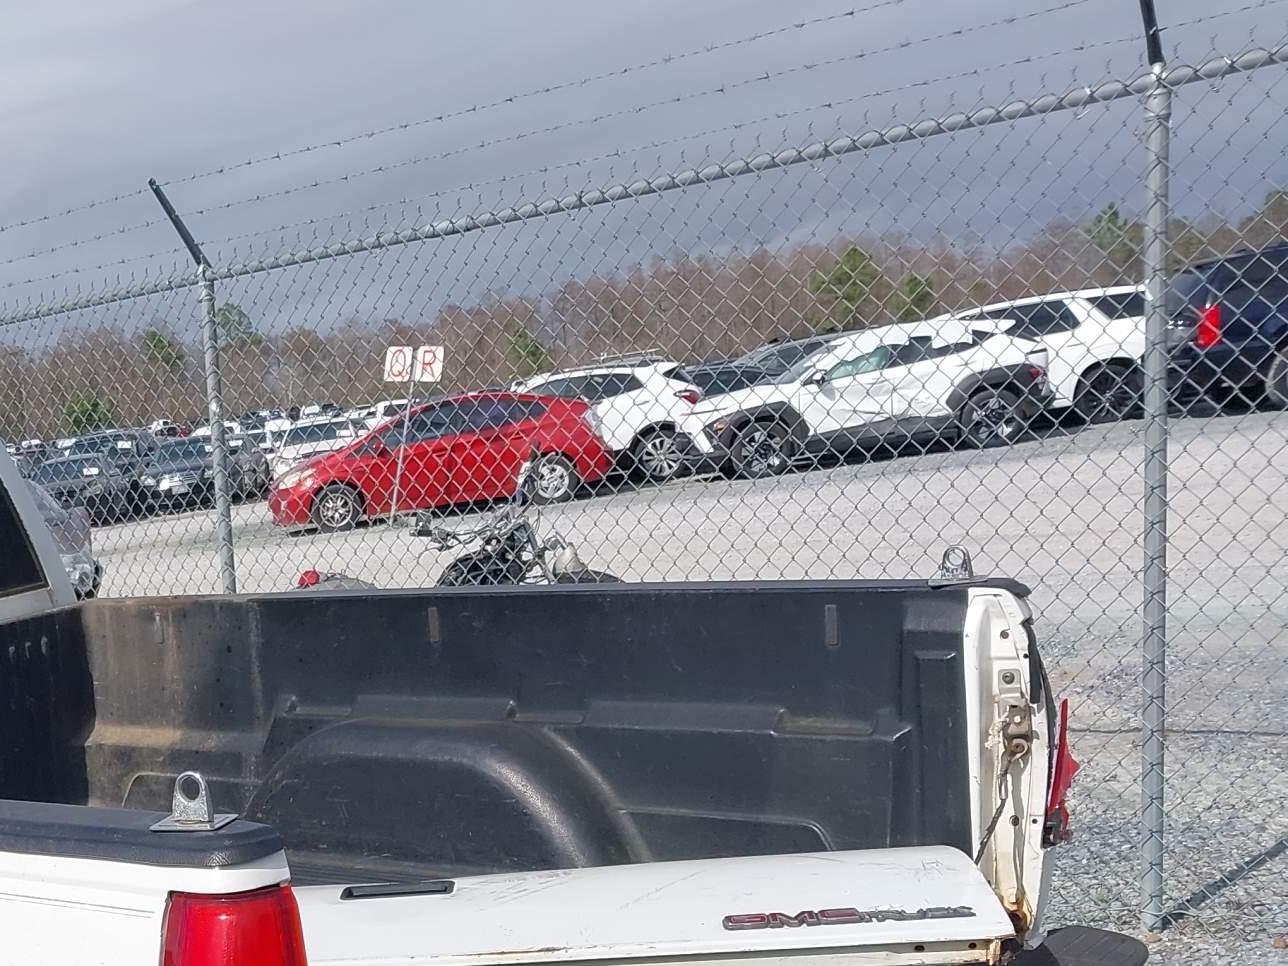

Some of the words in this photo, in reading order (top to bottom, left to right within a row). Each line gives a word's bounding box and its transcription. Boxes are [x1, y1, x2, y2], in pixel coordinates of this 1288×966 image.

[390, 349, 407, 377] Q
[421, 350, 437, 378] R
[722, 907, 861, 931] GMC
